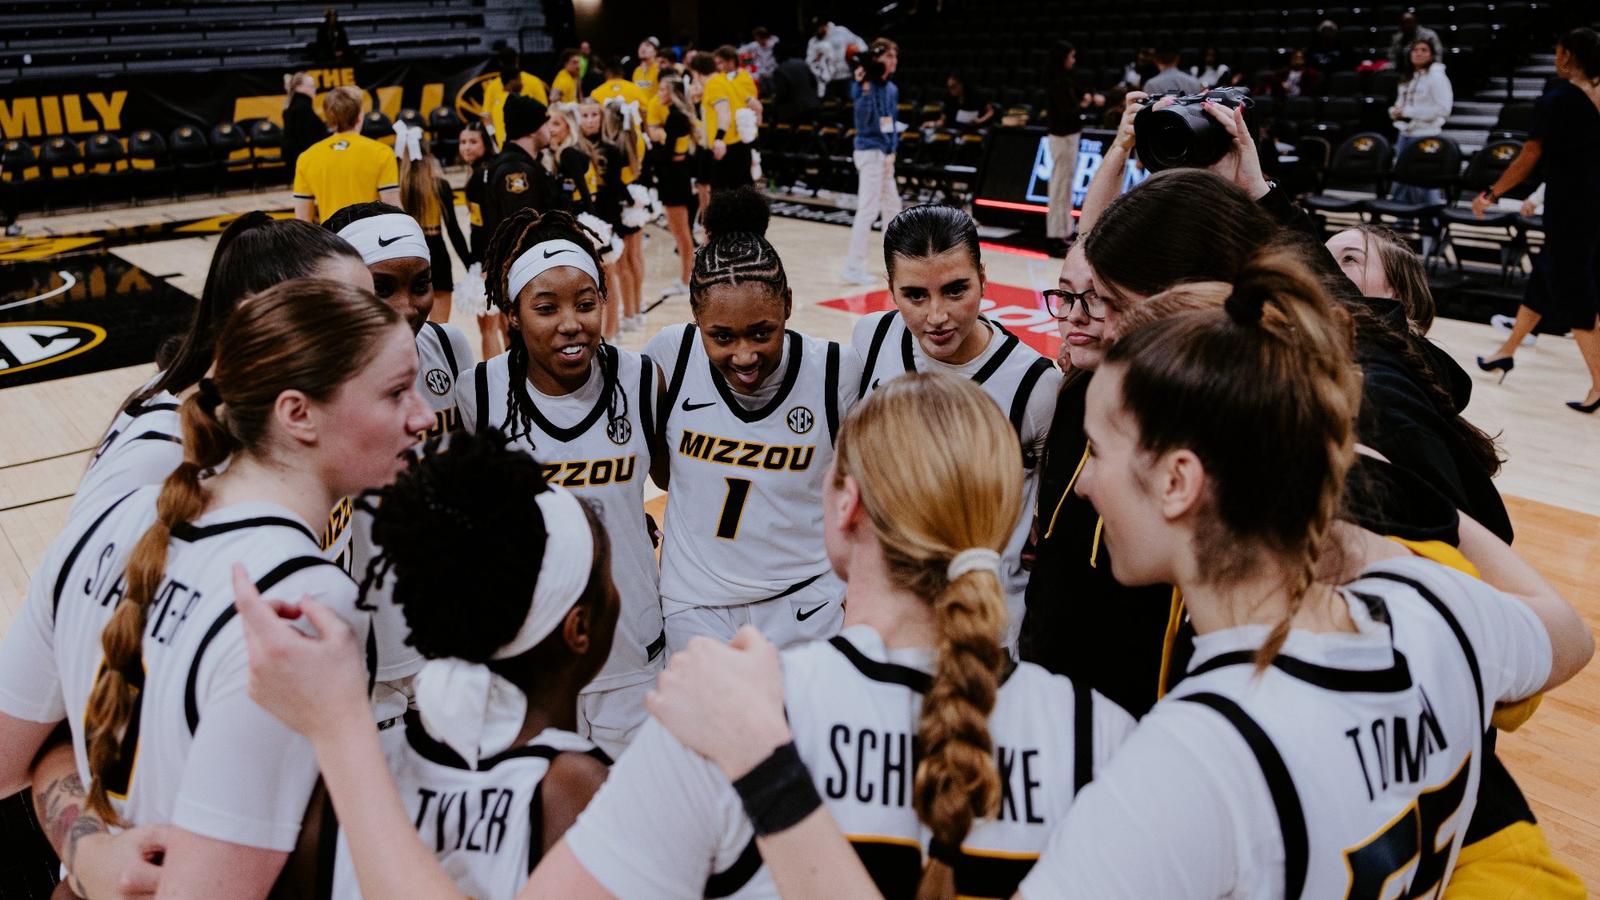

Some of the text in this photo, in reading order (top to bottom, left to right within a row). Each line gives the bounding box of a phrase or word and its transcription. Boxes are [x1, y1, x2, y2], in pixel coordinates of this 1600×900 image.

[427, 370, 450, 394] SEC
[787, 407, 814, 434] SEC
[543, 455, 637, 488] ZZOU
[678, 429, 816, 473] MIZZOU
[715, 476, 753, 542] 1
[826, 724, 1044, 824] SCHKE
[415, 788, 514, 854] TYLER
